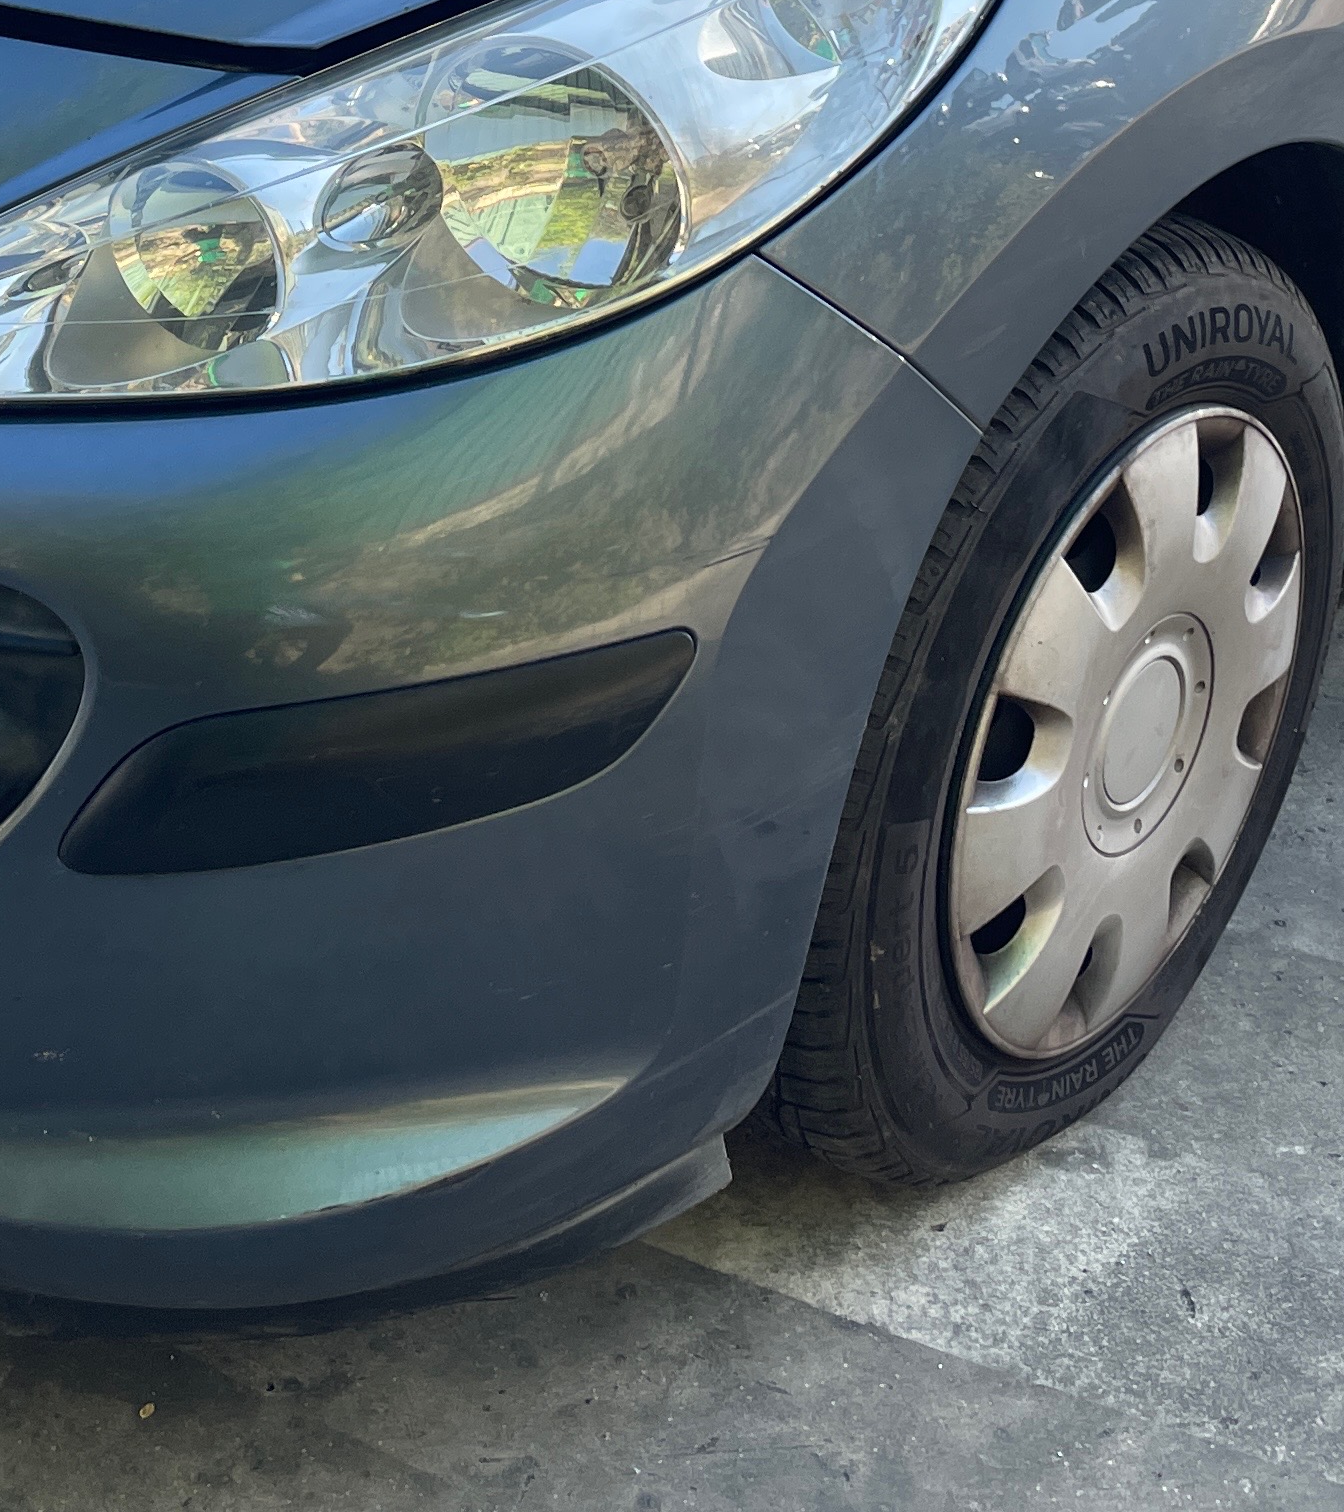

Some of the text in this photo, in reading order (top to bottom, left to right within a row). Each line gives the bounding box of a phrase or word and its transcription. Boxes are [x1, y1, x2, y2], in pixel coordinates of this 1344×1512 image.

[1142, 303, 1298, 378] UNIROYAL
[994, 1026, 1138, 1110] THE RAIN TYRE
